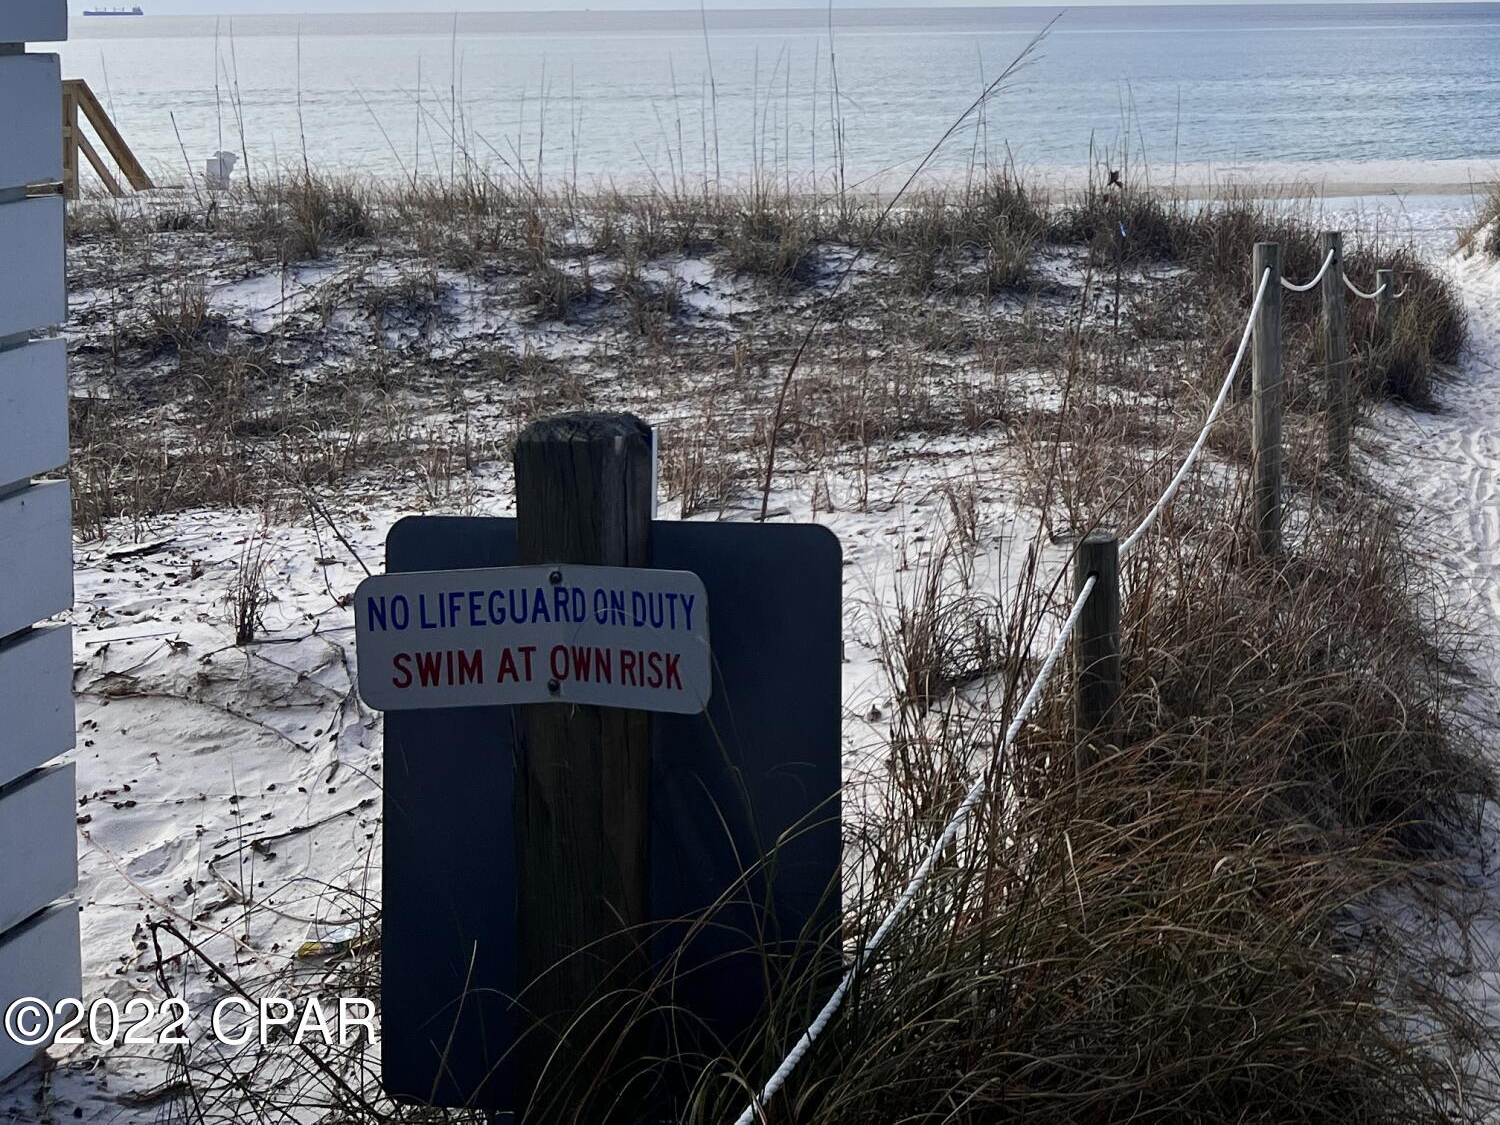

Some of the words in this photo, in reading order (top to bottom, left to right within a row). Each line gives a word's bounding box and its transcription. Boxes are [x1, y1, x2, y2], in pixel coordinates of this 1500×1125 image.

[367, 595, 410, 632] NO
[419, 586, 587, 629] LIFEGUARD
[594, 588, 626, 626] ON
[632, 590, 695, 631] DUTY
[392, 649, 483, 689] SWIM
[497, 646, 537, 683] AT
[550, 644, 612, 684] OWN
[620, 649, 683, 690] RISK
